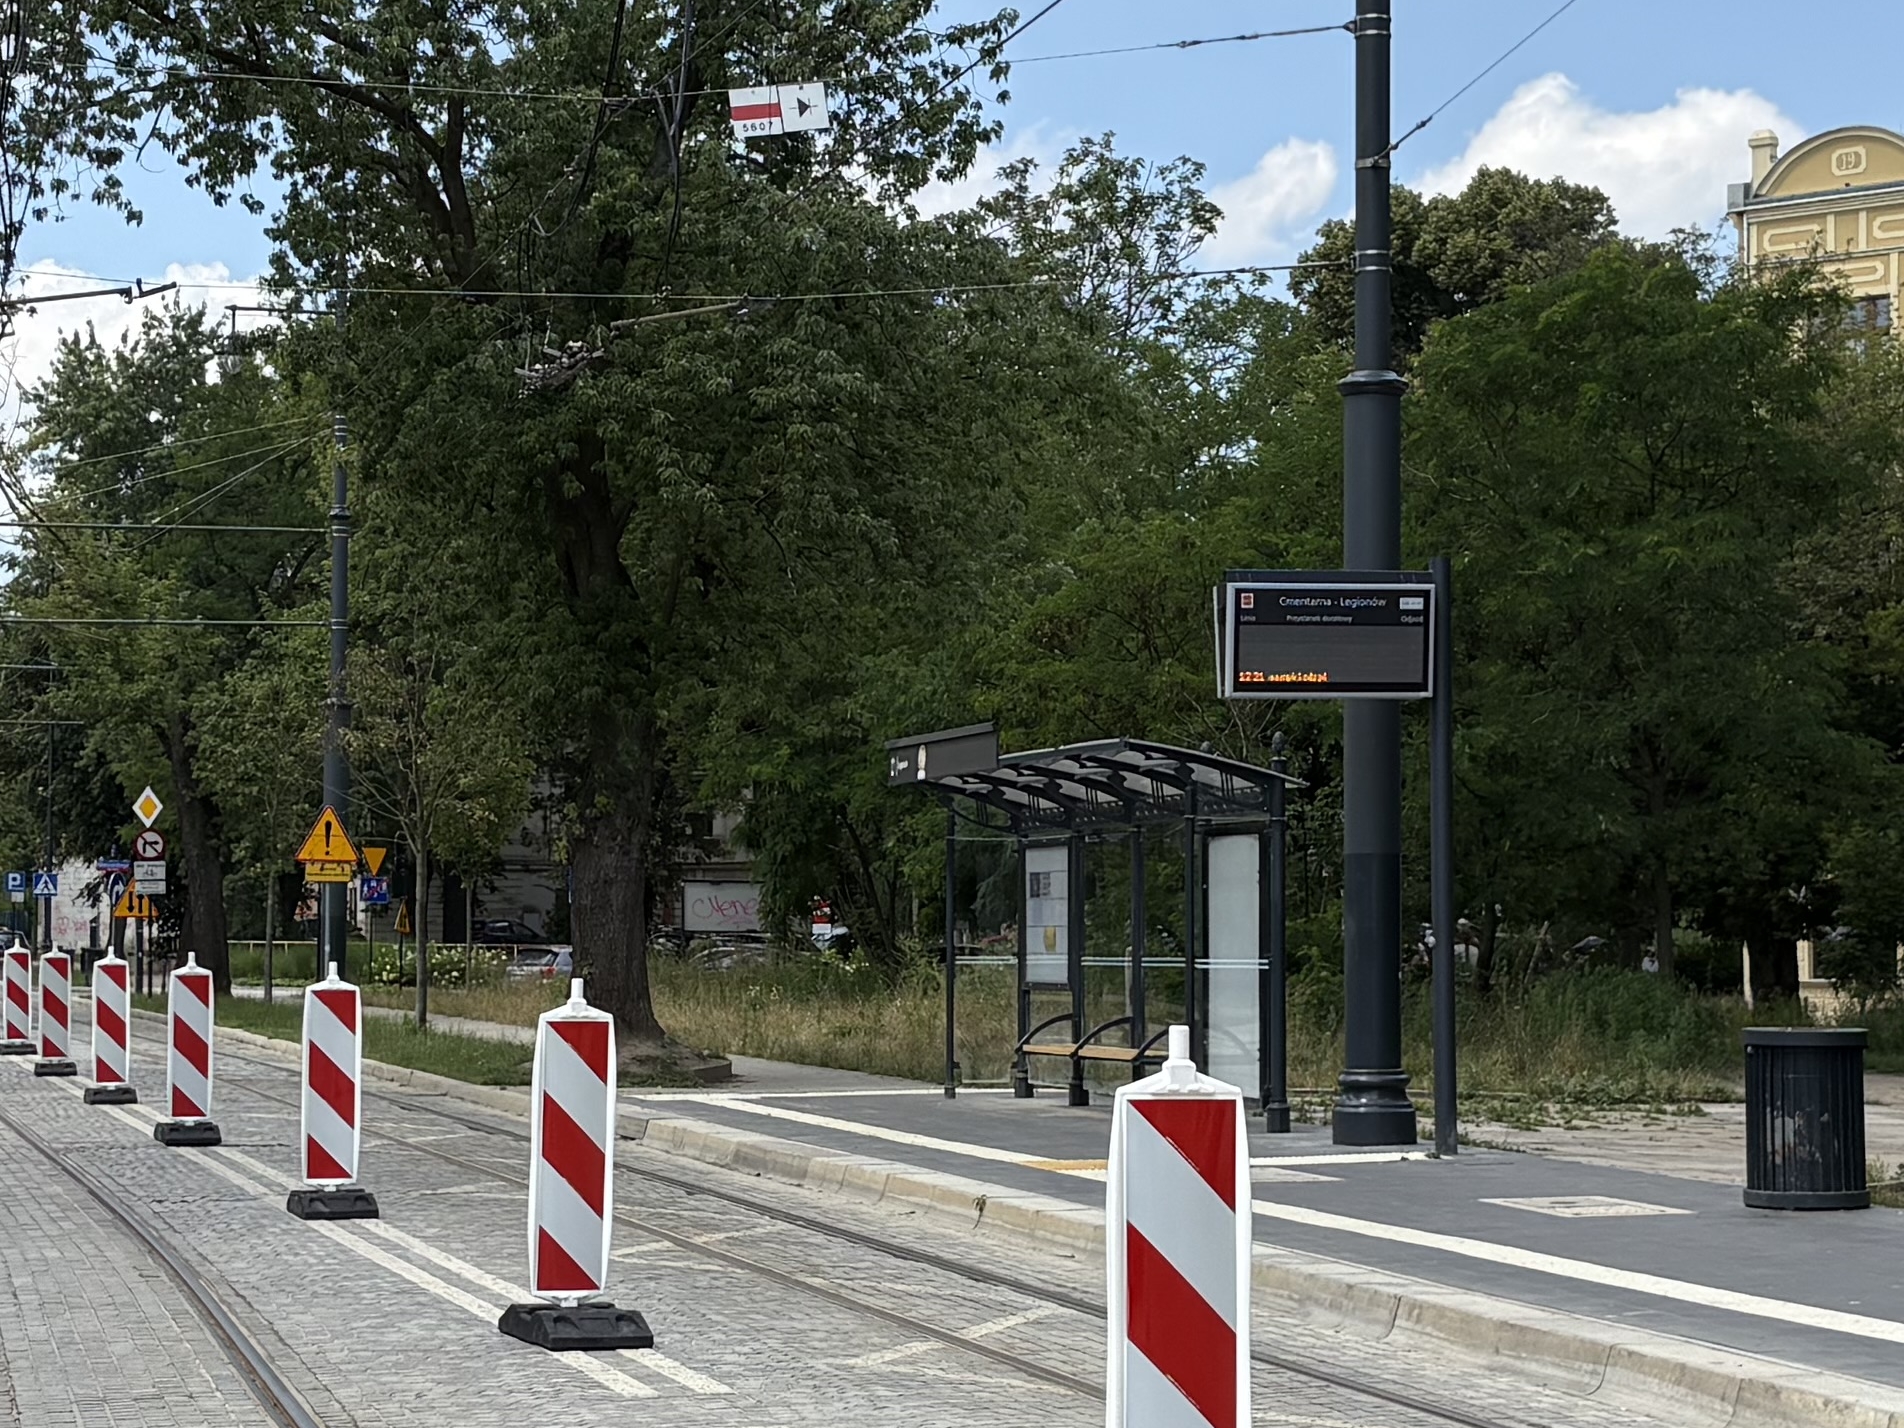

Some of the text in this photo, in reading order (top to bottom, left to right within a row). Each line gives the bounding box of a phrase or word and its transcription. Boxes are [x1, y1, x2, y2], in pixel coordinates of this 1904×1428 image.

[742, 122, 773, 132] 5607
[1339, 595, 1387, 608] Legionów
[8, 873, 20, 890] P
